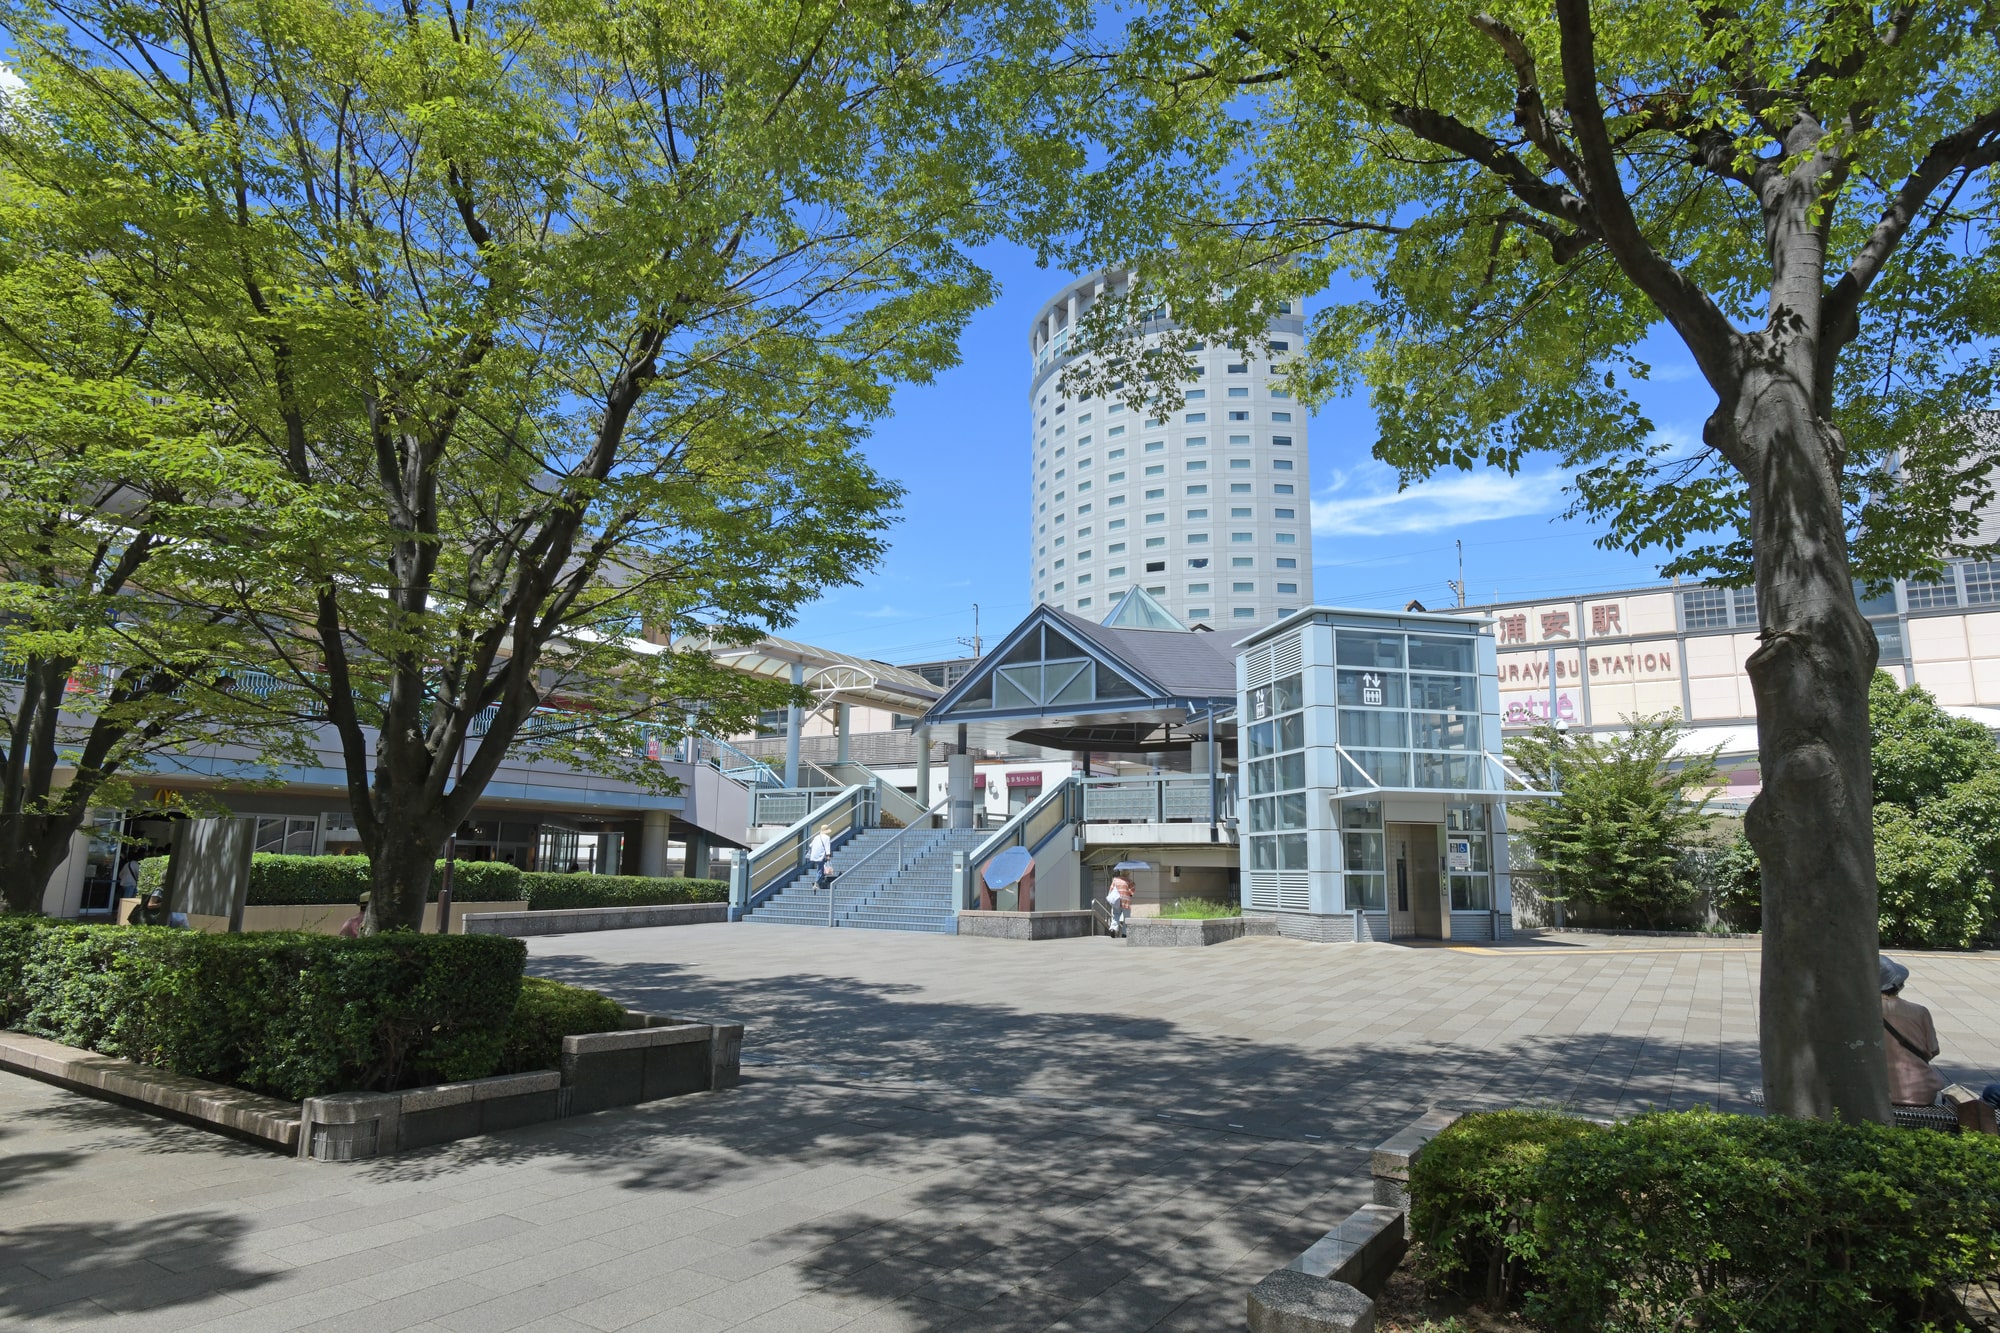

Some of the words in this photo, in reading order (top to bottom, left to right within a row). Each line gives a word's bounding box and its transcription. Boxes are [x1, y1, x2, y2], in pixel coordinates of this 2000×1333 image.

[1500, 604, 1622, 643] 浦安駅
[1497, 659, 1579, 683] URAYASU
[1589, 652, 1671, 677] STATION
